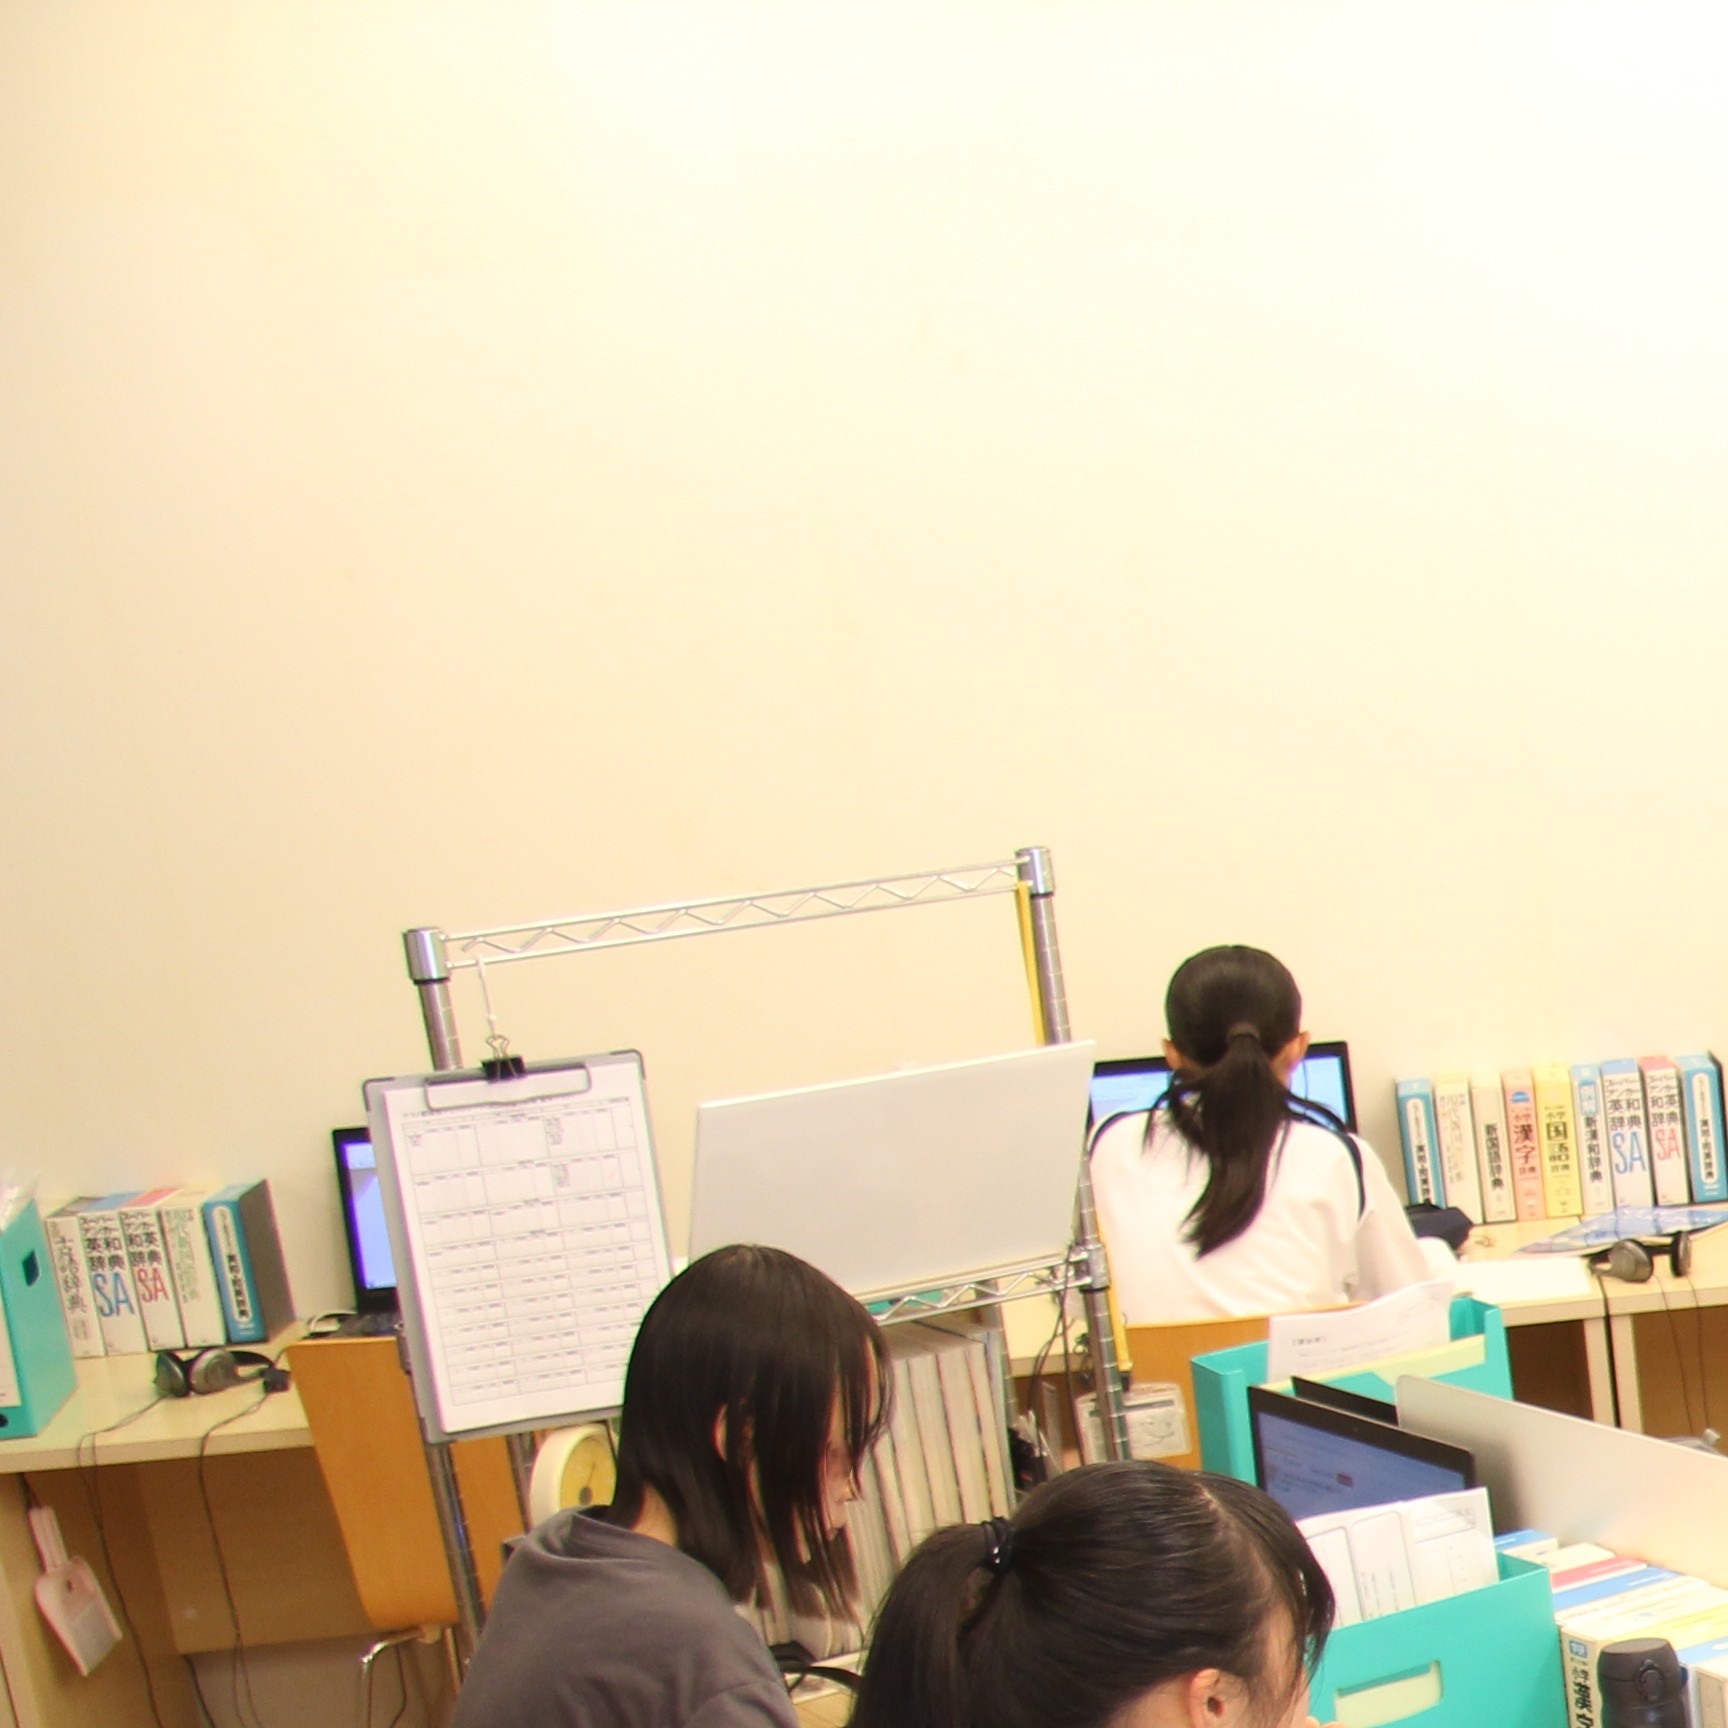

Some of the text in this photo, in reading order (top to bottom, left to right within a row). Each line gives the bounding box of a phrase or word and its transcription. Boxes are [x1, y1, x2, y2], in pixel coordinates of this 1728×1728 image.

[1612, 1131, 1646, 1174] SA
[1655, 1128, 1681, 1161] SA
[92, 1272, 135, 1317] SA
[136, 1267, 170, 1302] SA
